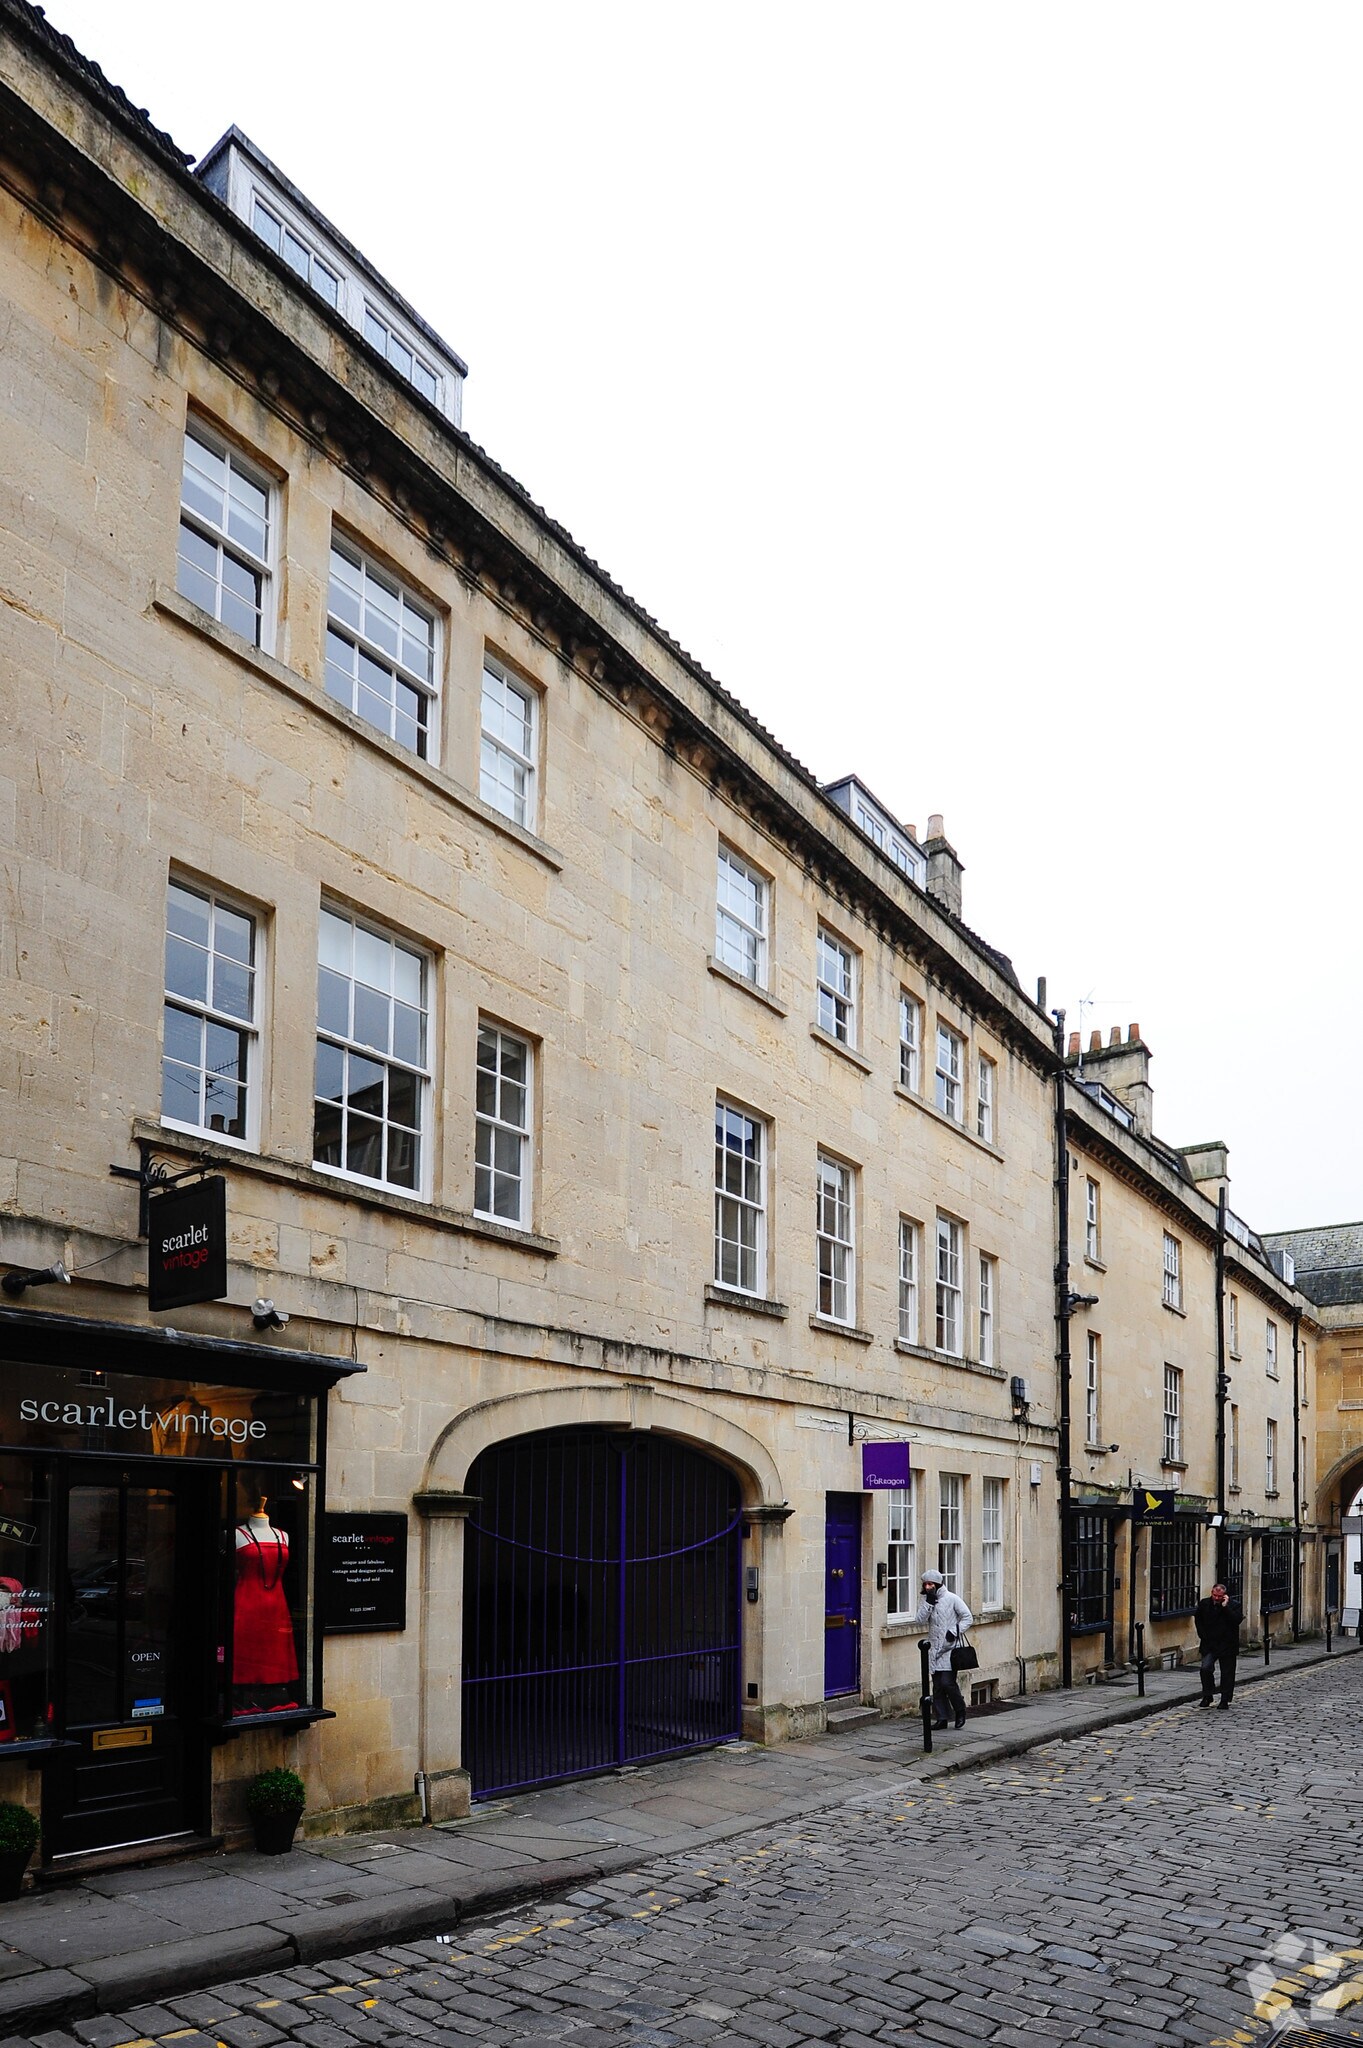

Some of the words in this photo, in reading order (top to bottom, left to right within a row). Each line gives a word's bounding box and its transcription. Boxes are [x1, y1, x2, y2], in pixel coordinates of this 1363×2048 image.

[162, 1223, 209, 1253] scarlet
[162, 1247, 209, 1272] vintage
[0, 1521, 24, 1538] EN
[28, 1588, 41, 1598] in
[131, 1652, 161, 1662] OPEN
